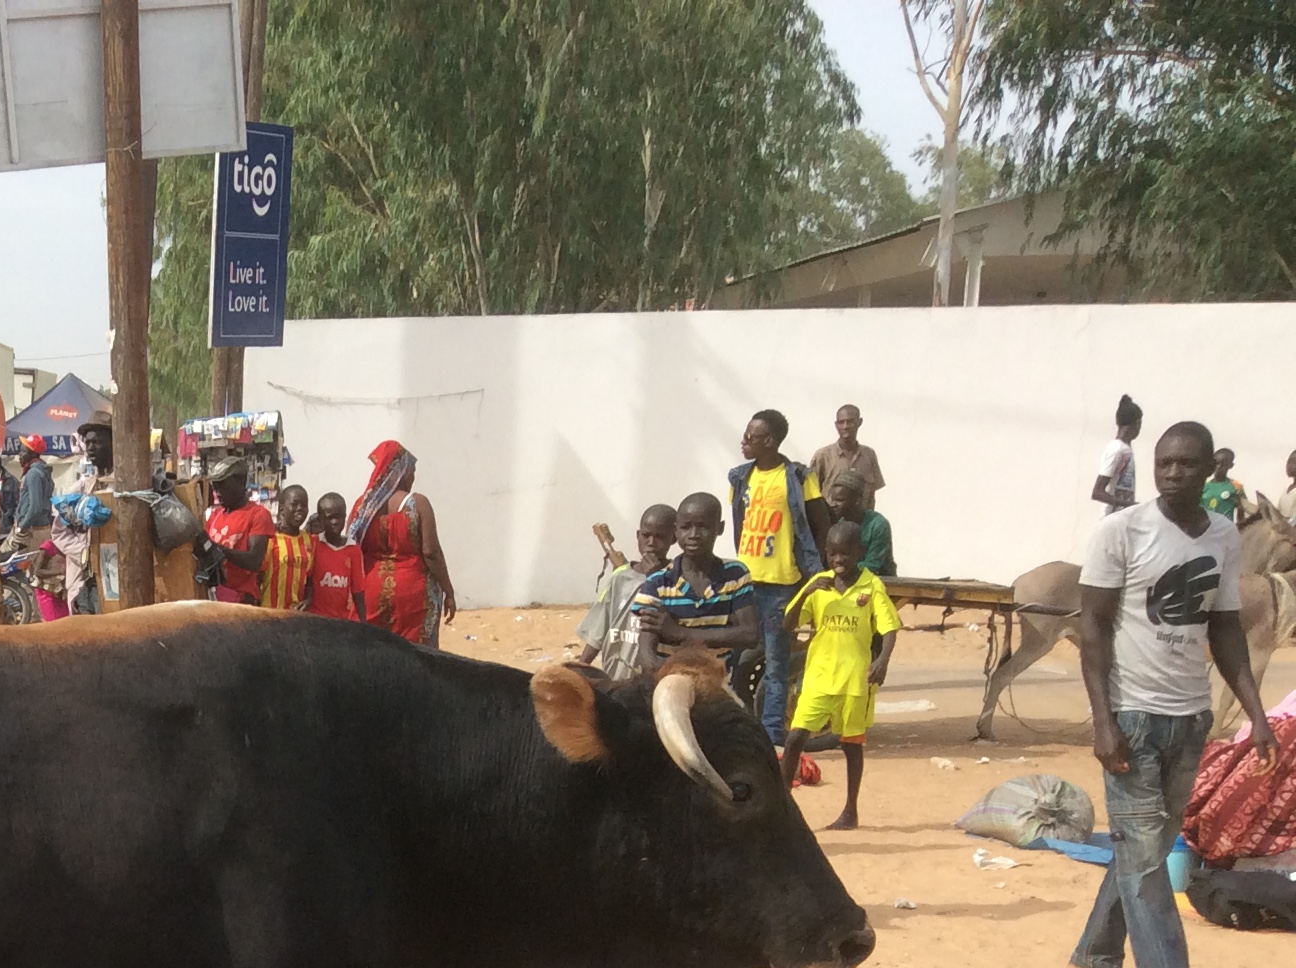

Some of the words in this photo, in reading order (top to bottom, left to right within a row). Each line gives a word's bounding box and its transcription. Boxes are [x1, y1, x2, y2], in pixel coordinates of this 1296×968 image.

[229, 261, 253, 284] Live
[255, 261, 267, 284] it.
[228, 290, 256, 312] Love
[258, 289, 270, 312] it.
[49, 409, 77, 418] PLANET
